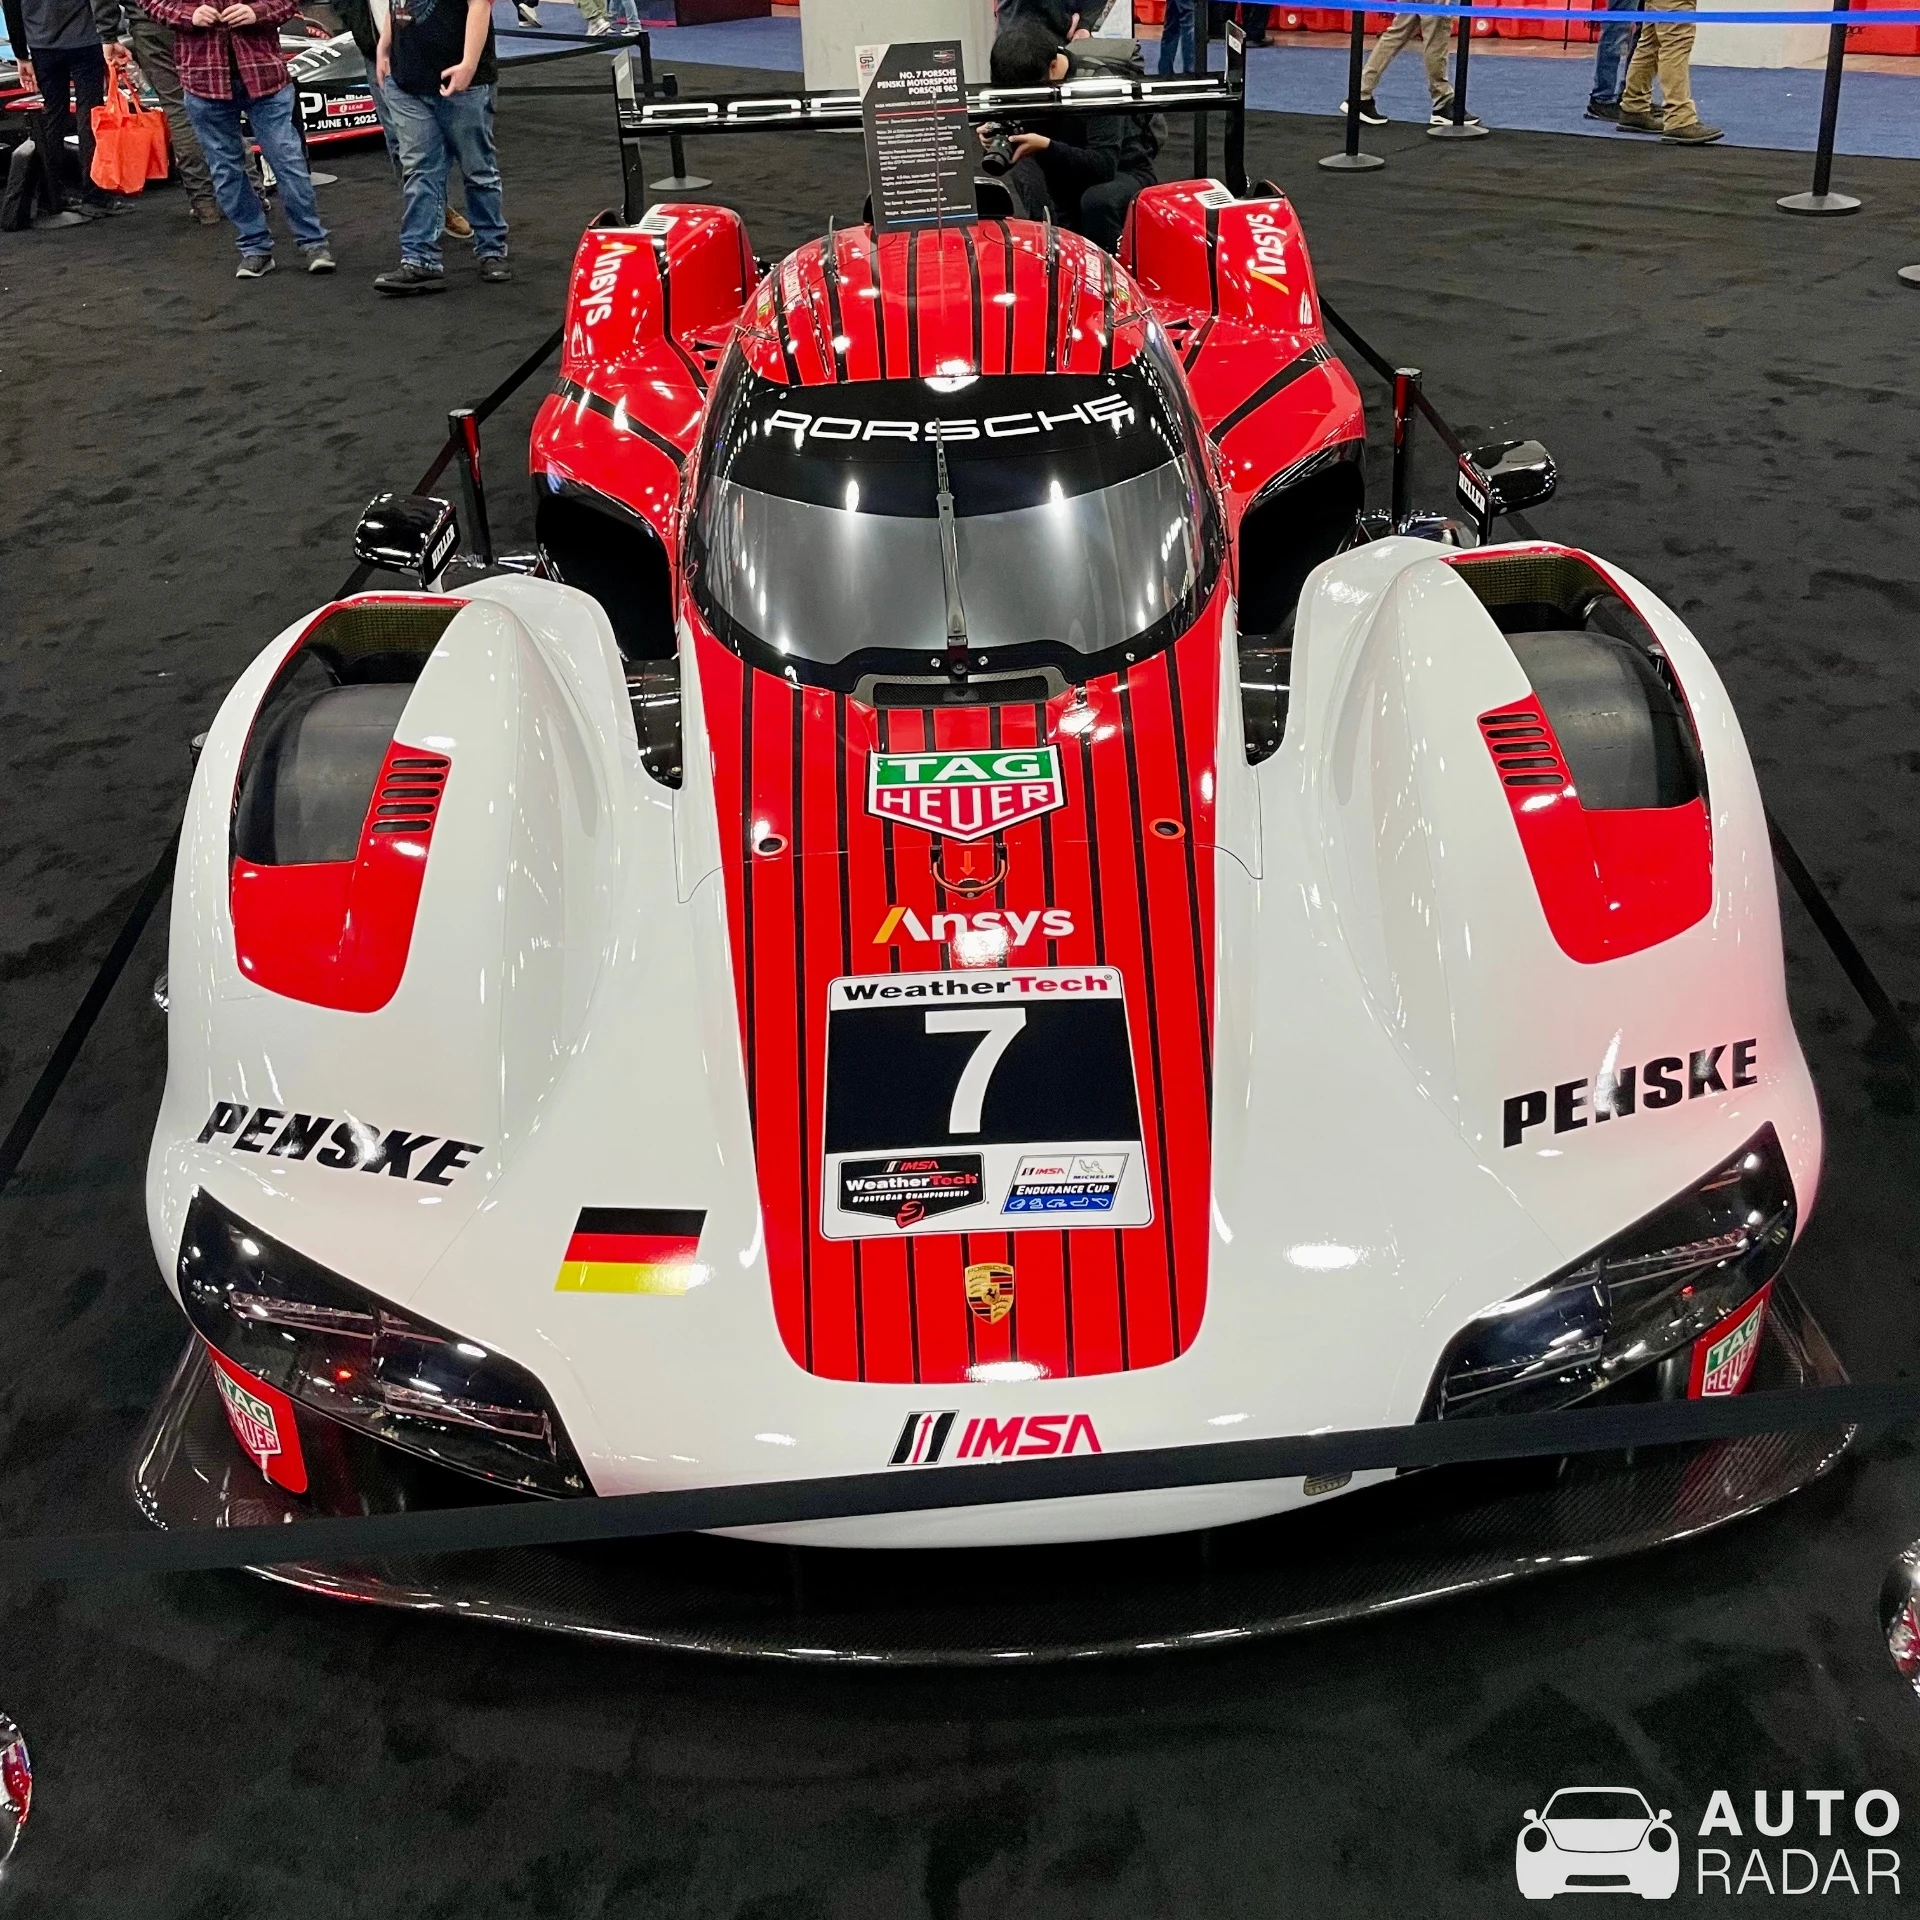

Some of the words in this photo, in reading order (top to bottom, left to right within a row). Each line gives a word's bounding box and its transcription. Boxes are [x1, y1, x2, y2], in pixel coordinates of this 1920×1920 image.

[877, 79, 906, 89] PENSKE
[906, 77, 957, 87] MOTORSPORT
[899, 71, 915, 80] NO.
[915, 71, 922, 79] 7
[922, 69, 957, 78] PORSCHE
[908, 86, 943, 95] PORSCHE
[943, 85, 958, 93] 963
[344, 117, 352, 129] 1,
[354, 113, 378, 125] 2025
[1245, 213, 1290, 295] Ansys
[580, 242, 638, 327] Ansys
[768, 394, 1132, 442] PORSCHE
[887, 754, 1041, 782] TAG
[882, 784, 1049, 831] HEUER
[872, 906, 1075, 947] Ansys
[924, 1007, 1027, 1135] 7
[1503, 1037, 1758, 1149] PENSKE
[195, 1101, 485, 1187] PENSKE
[900, 1160, 940, 1171] IMSA
[1034, 1167, 1066, 1175] IMSA
[1712, 1310, 1759, 1364] TAG
[221, 1379, 271, 1427] TAG
[956, 1414, 1103, 1459] IMSA
